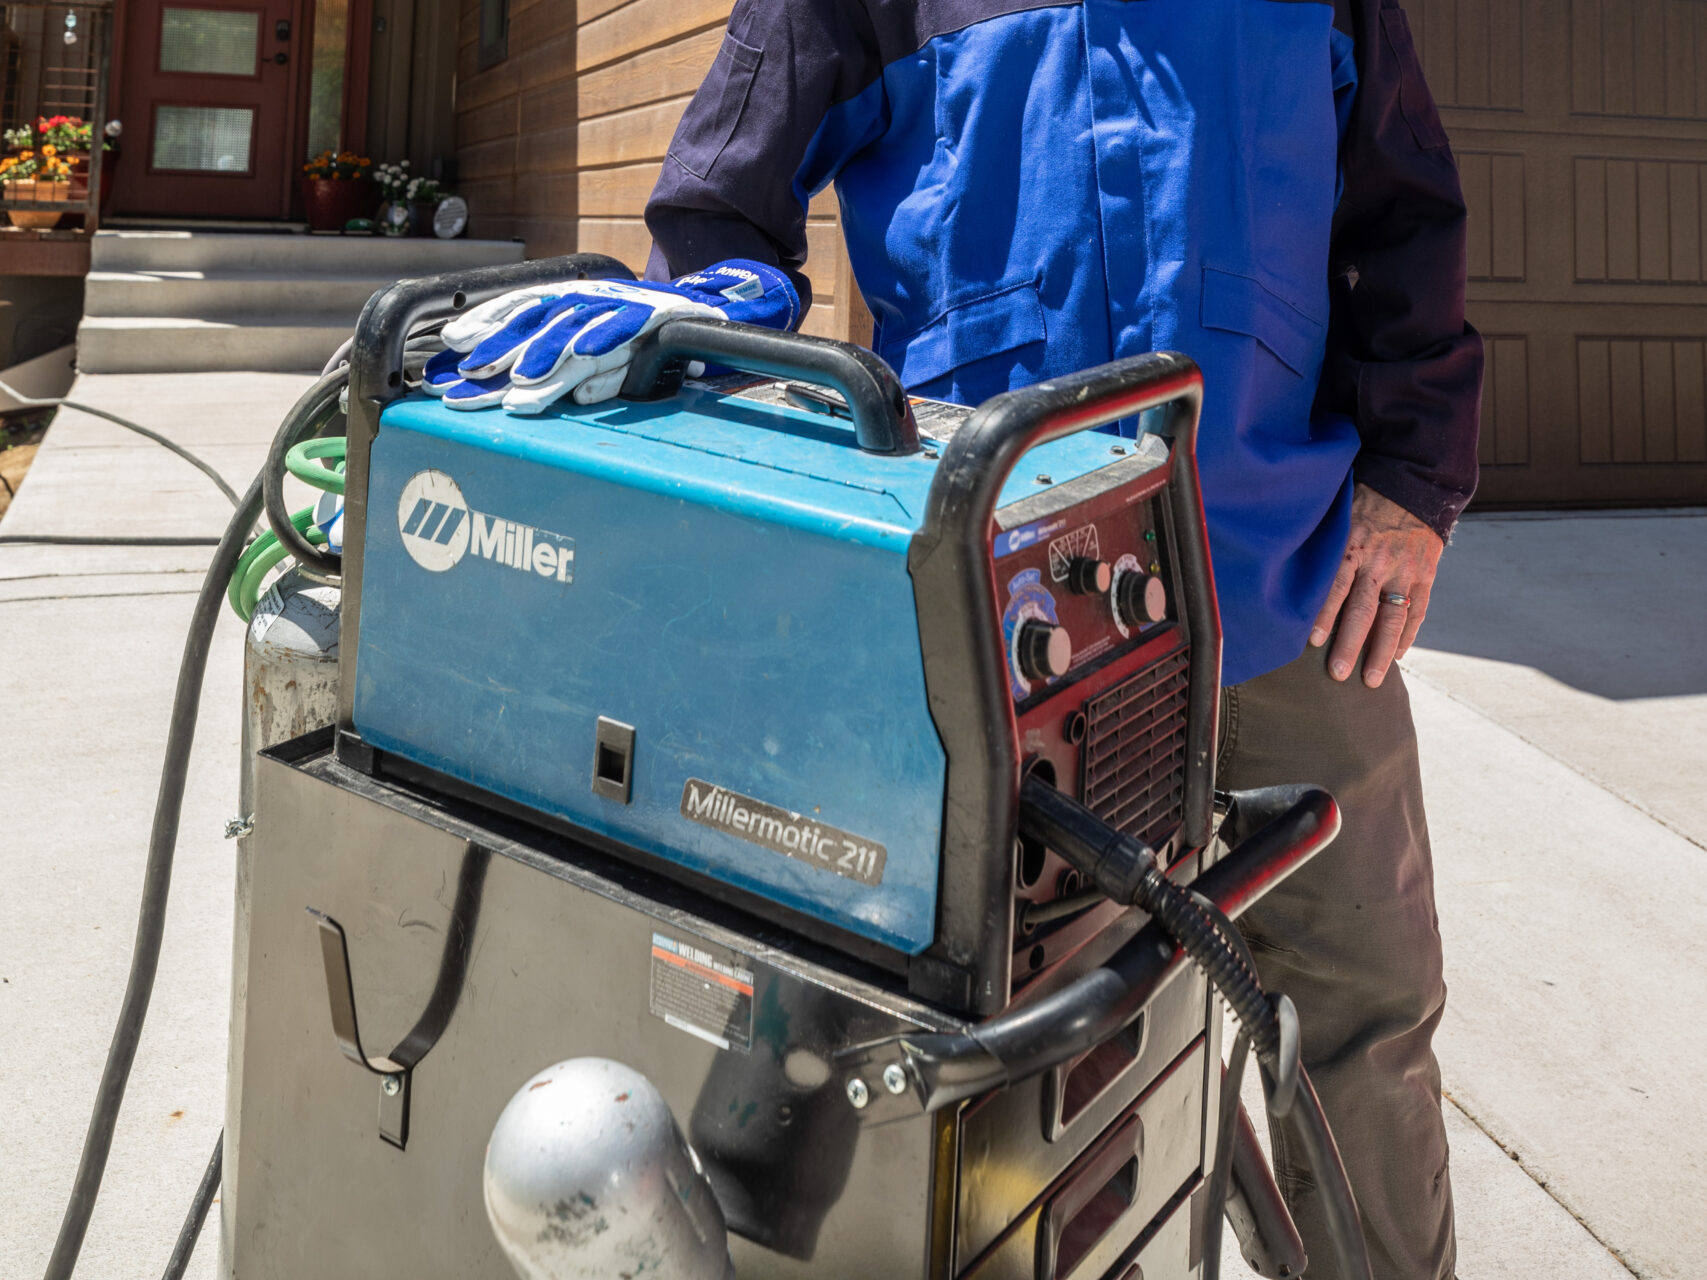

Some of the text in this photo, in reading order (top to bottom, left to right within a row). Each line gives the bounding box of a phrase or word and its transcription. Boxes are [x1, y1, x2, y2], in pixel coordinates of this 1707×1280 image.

[470, 511, 575, 582] Miller
[687, 784, 878, 878] Millermatic 211
[679, 941, 713, 969] WELDING
